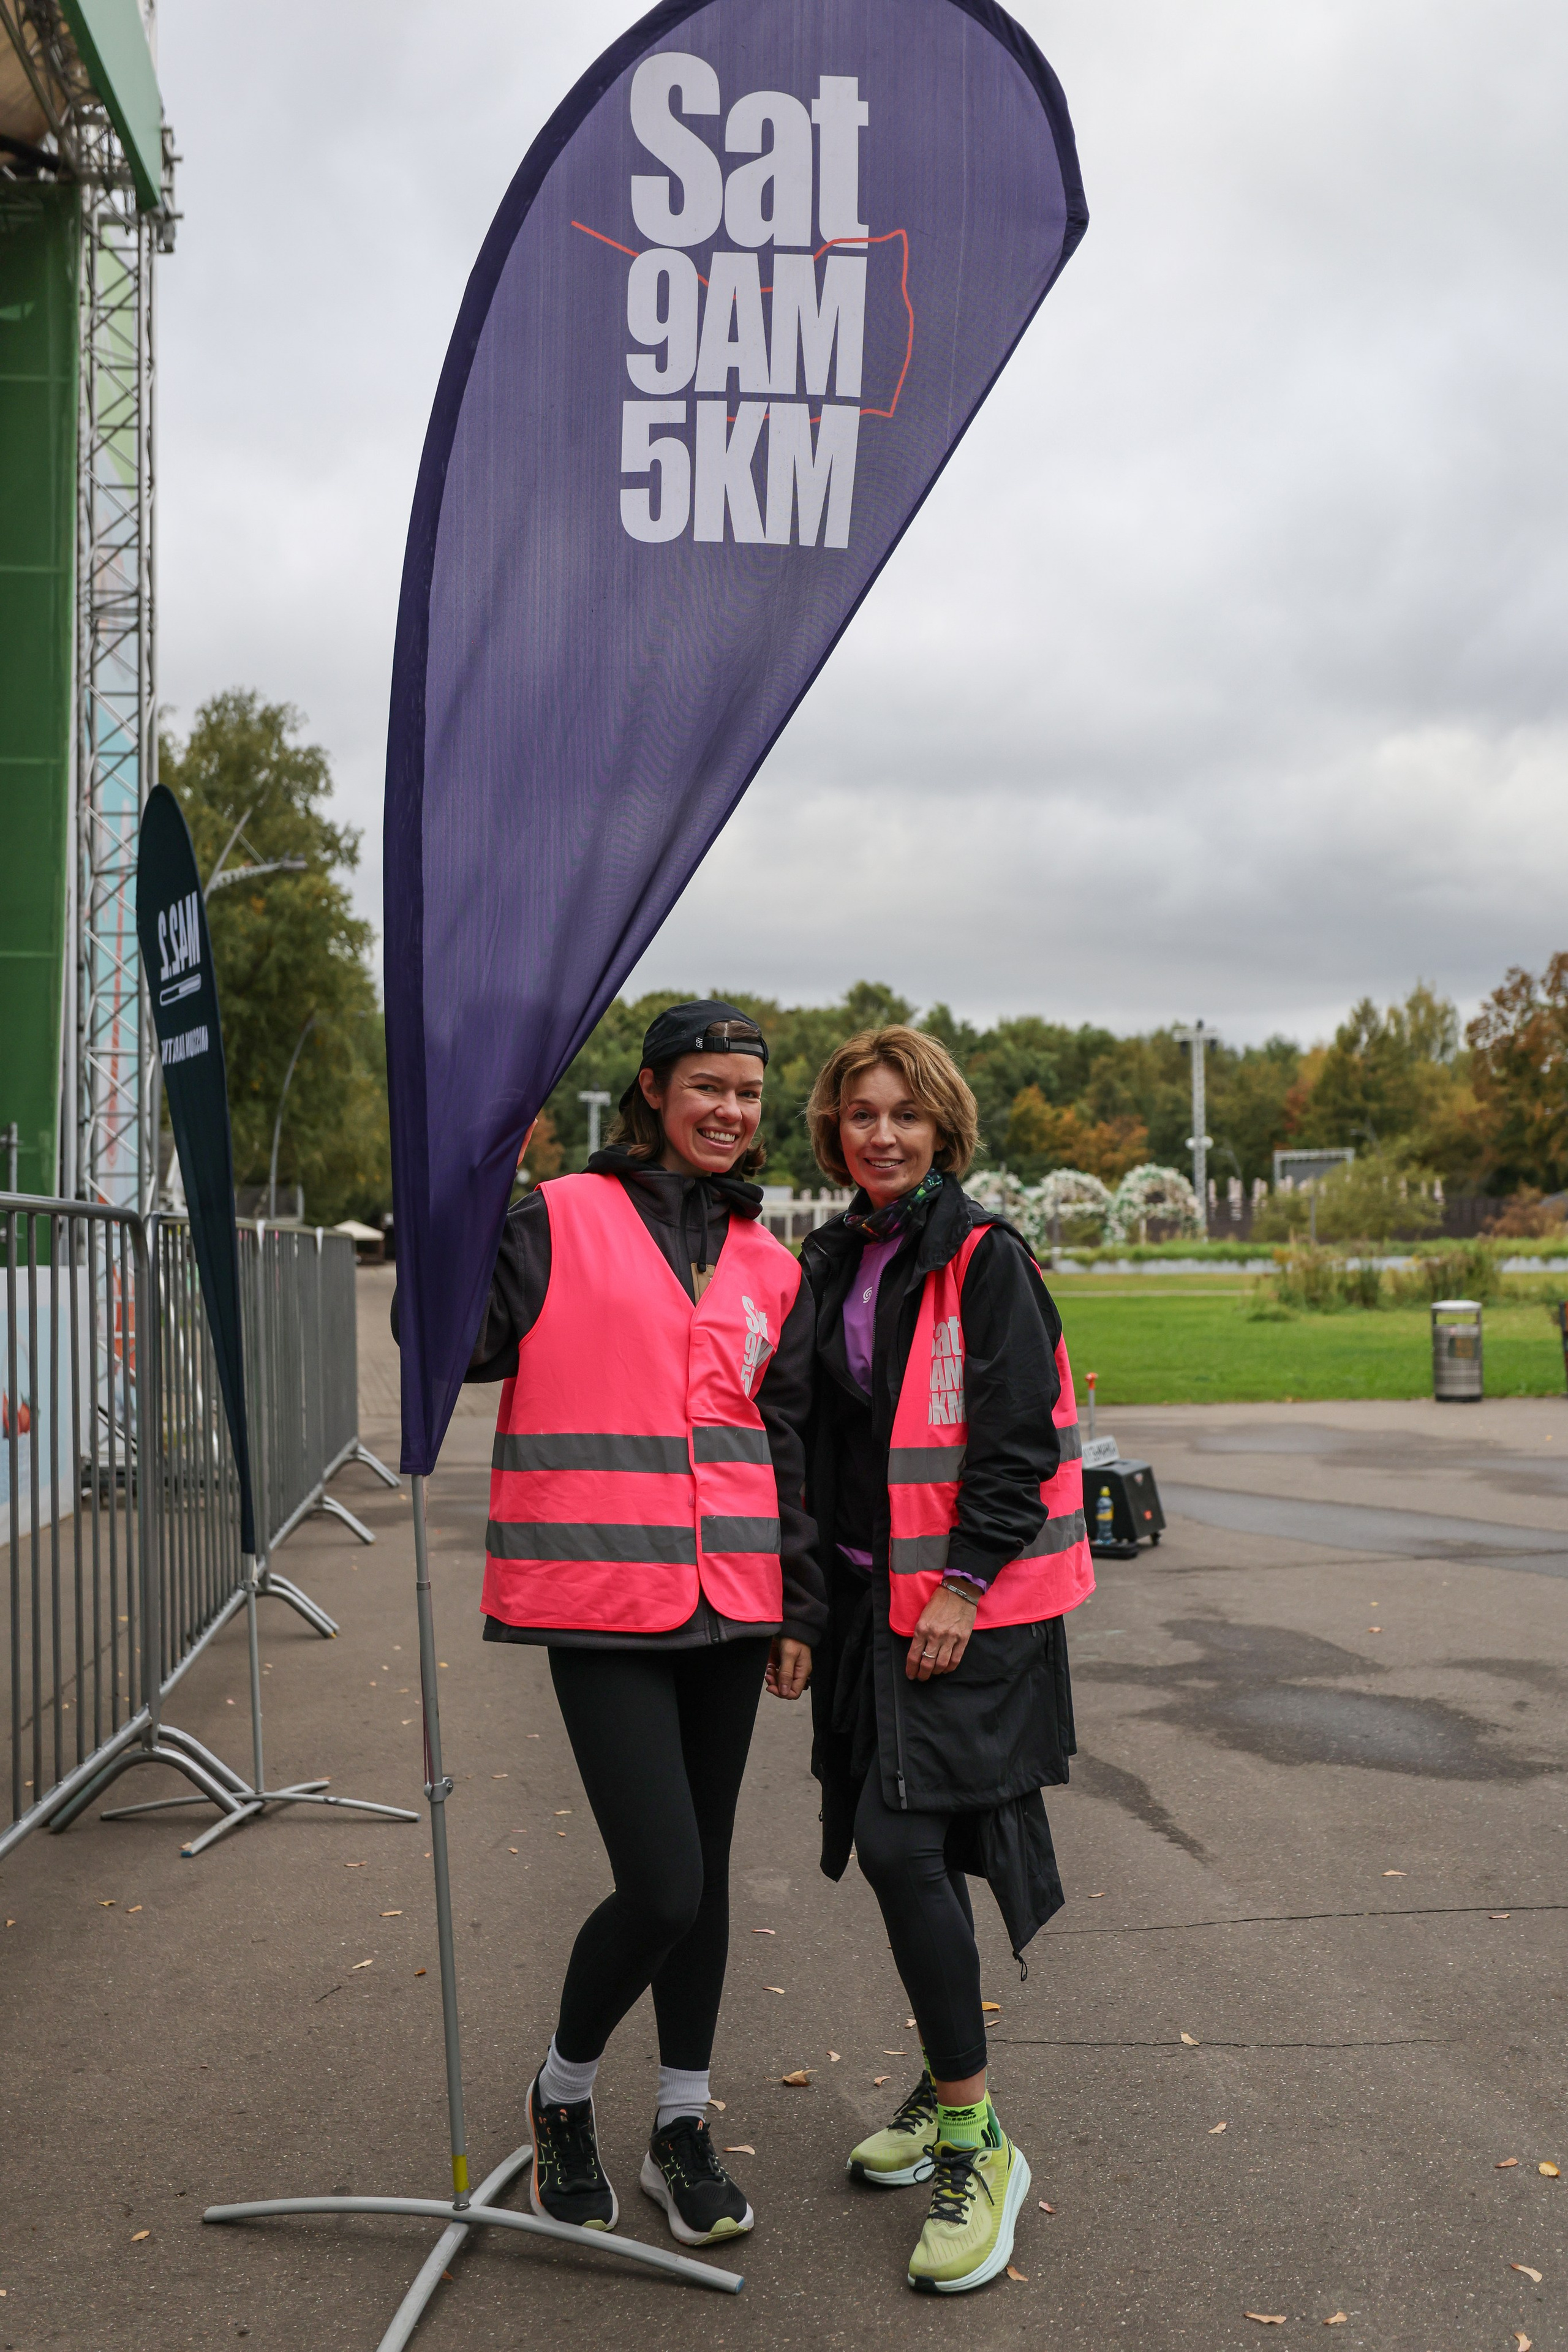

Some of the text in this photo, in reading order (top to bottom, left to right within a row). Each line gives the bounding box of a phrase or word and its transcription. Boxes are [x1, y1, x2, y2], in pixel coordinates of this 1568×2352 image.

[630, 51, 869, 249] Sat
[626, 248, 867, 398] 9AM
[620, 400, 861, 549] 5KM
[928, 1390, 967, 1425] KM
[929, 1356, 964, 1392] AM
